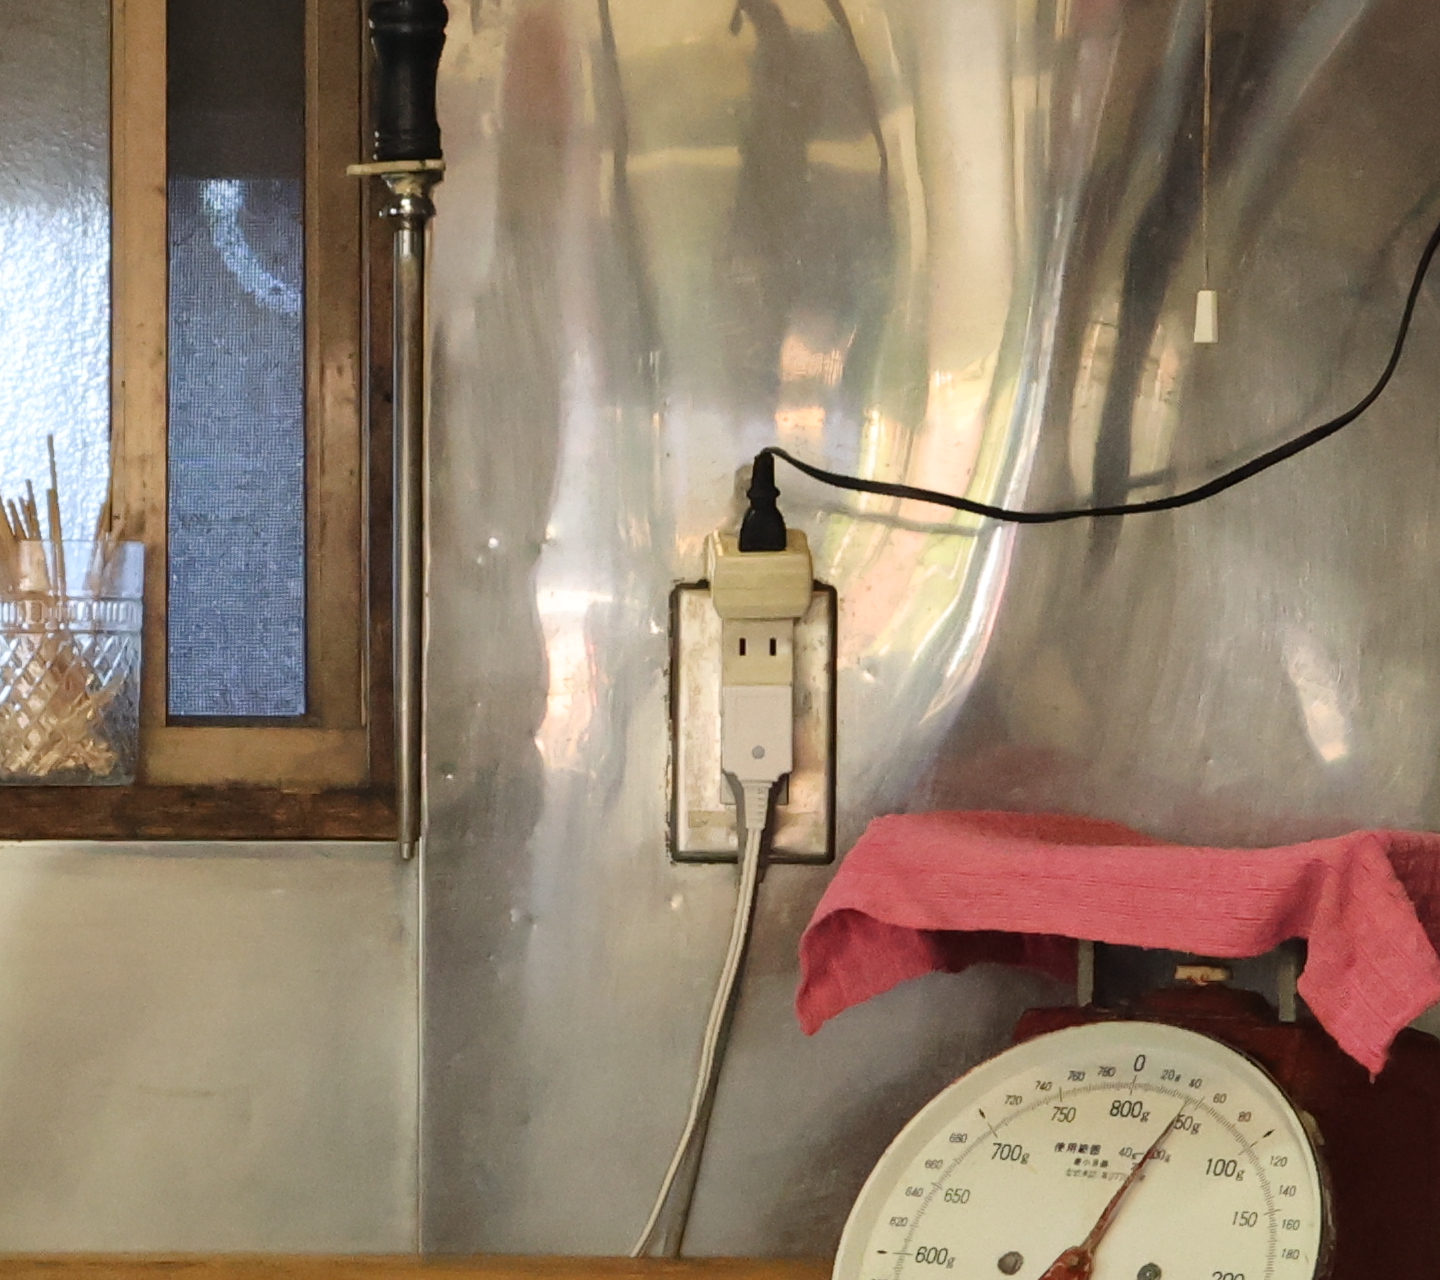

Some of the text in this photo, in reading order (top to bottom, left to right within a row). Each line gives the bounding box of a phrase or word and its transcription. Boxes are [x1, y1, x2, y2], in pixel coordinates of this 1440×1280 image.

[1133, 1054, 1146, 1073] 0
[1035, 1080, 1053, 1092] 740
[1004, 1094, 1023, 1106] 720
[1213, 1093, 1228, 1104] 60
[1051, 1106, 1077, 1123] 750
[1109, 1099, 1151, 1123] 800g
[1237, 1111, 1252, 1123] 80
[1173, 1113, 1202, 1136] 50g
[991, 1142, 1031, 1166] 700g
[1270, 1155, 1288, 1168] 120
[1205, 1158, 1246, 1182] 100g
[905, 1186, 924, 1198] 640
[943, 1187, 971, 1204] 650
[1278, 1184, 1297, 1197] 140
[889, 1216, 909, 1227] 620
[1231, 1211, 1258, 1228] 150
[1281, 1218, 1300, 1231] 160
[915, 1246, 956, 1269] 600g
[1281, 1248, 1300, 1260] 180
